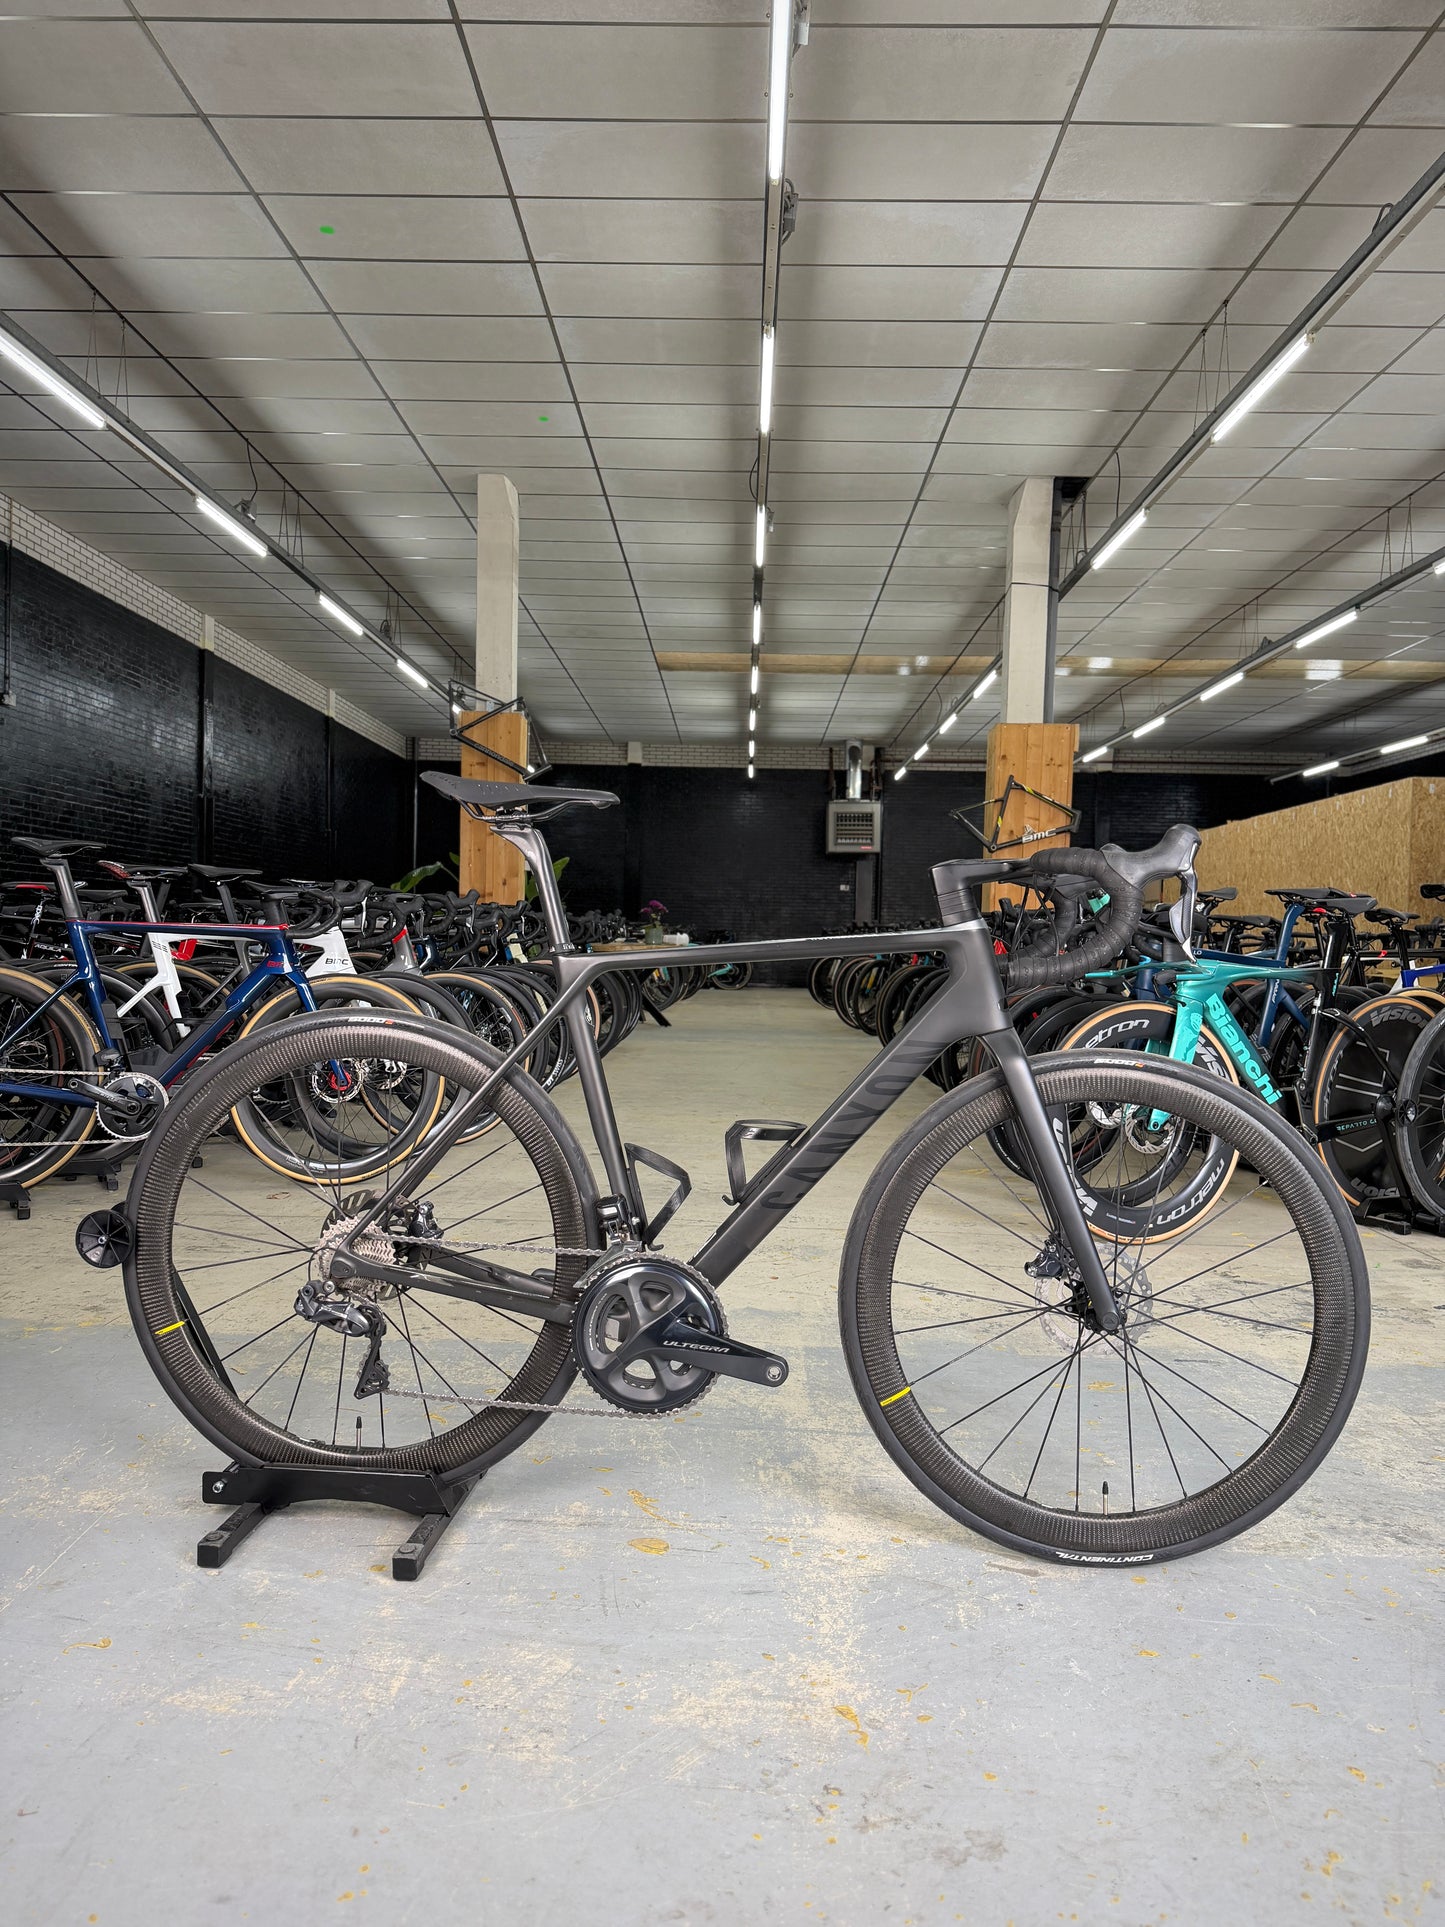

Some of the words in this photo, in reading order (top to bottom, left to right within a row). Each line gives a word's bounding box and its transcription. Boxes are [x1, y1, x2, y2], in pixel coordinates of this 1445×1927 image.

[325, 957, 349, 966] BMC
[1083, 1019, 1150, 1049] etron
[1205, 993, 1283, 1105] Bianchi
[759, 1039, 949, 1210] CANYON
[1156, 1158, 1226, 1226] metron
[663, 1340, 730, 1353] ULTEGRA
[1055, 1551, 1154, 1564] CONTINENTAL
